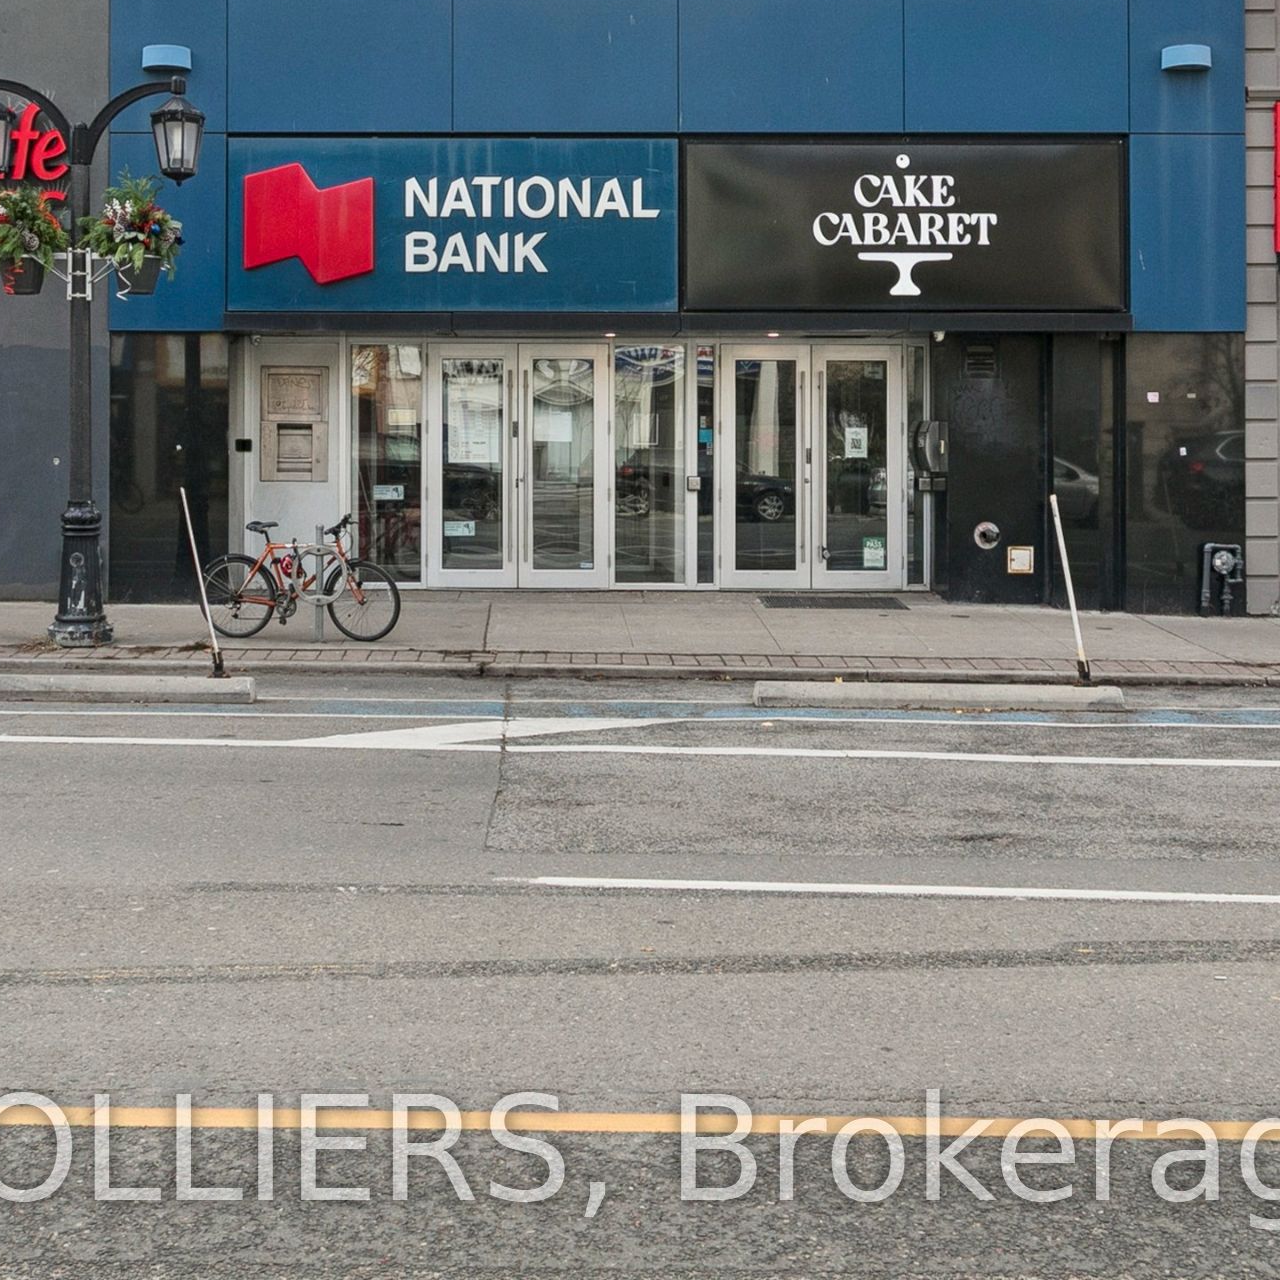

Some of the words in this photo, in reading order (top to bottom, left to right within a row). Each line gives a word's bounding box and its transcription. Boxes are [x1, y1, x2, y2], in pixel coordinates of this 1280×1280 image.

[405, 175, 661, 219] NATIONAL
[854, 174, 956, 208] CAKE
[812, 212, 998, 246] CABARET
[405, 231, 549, 273] BANK
